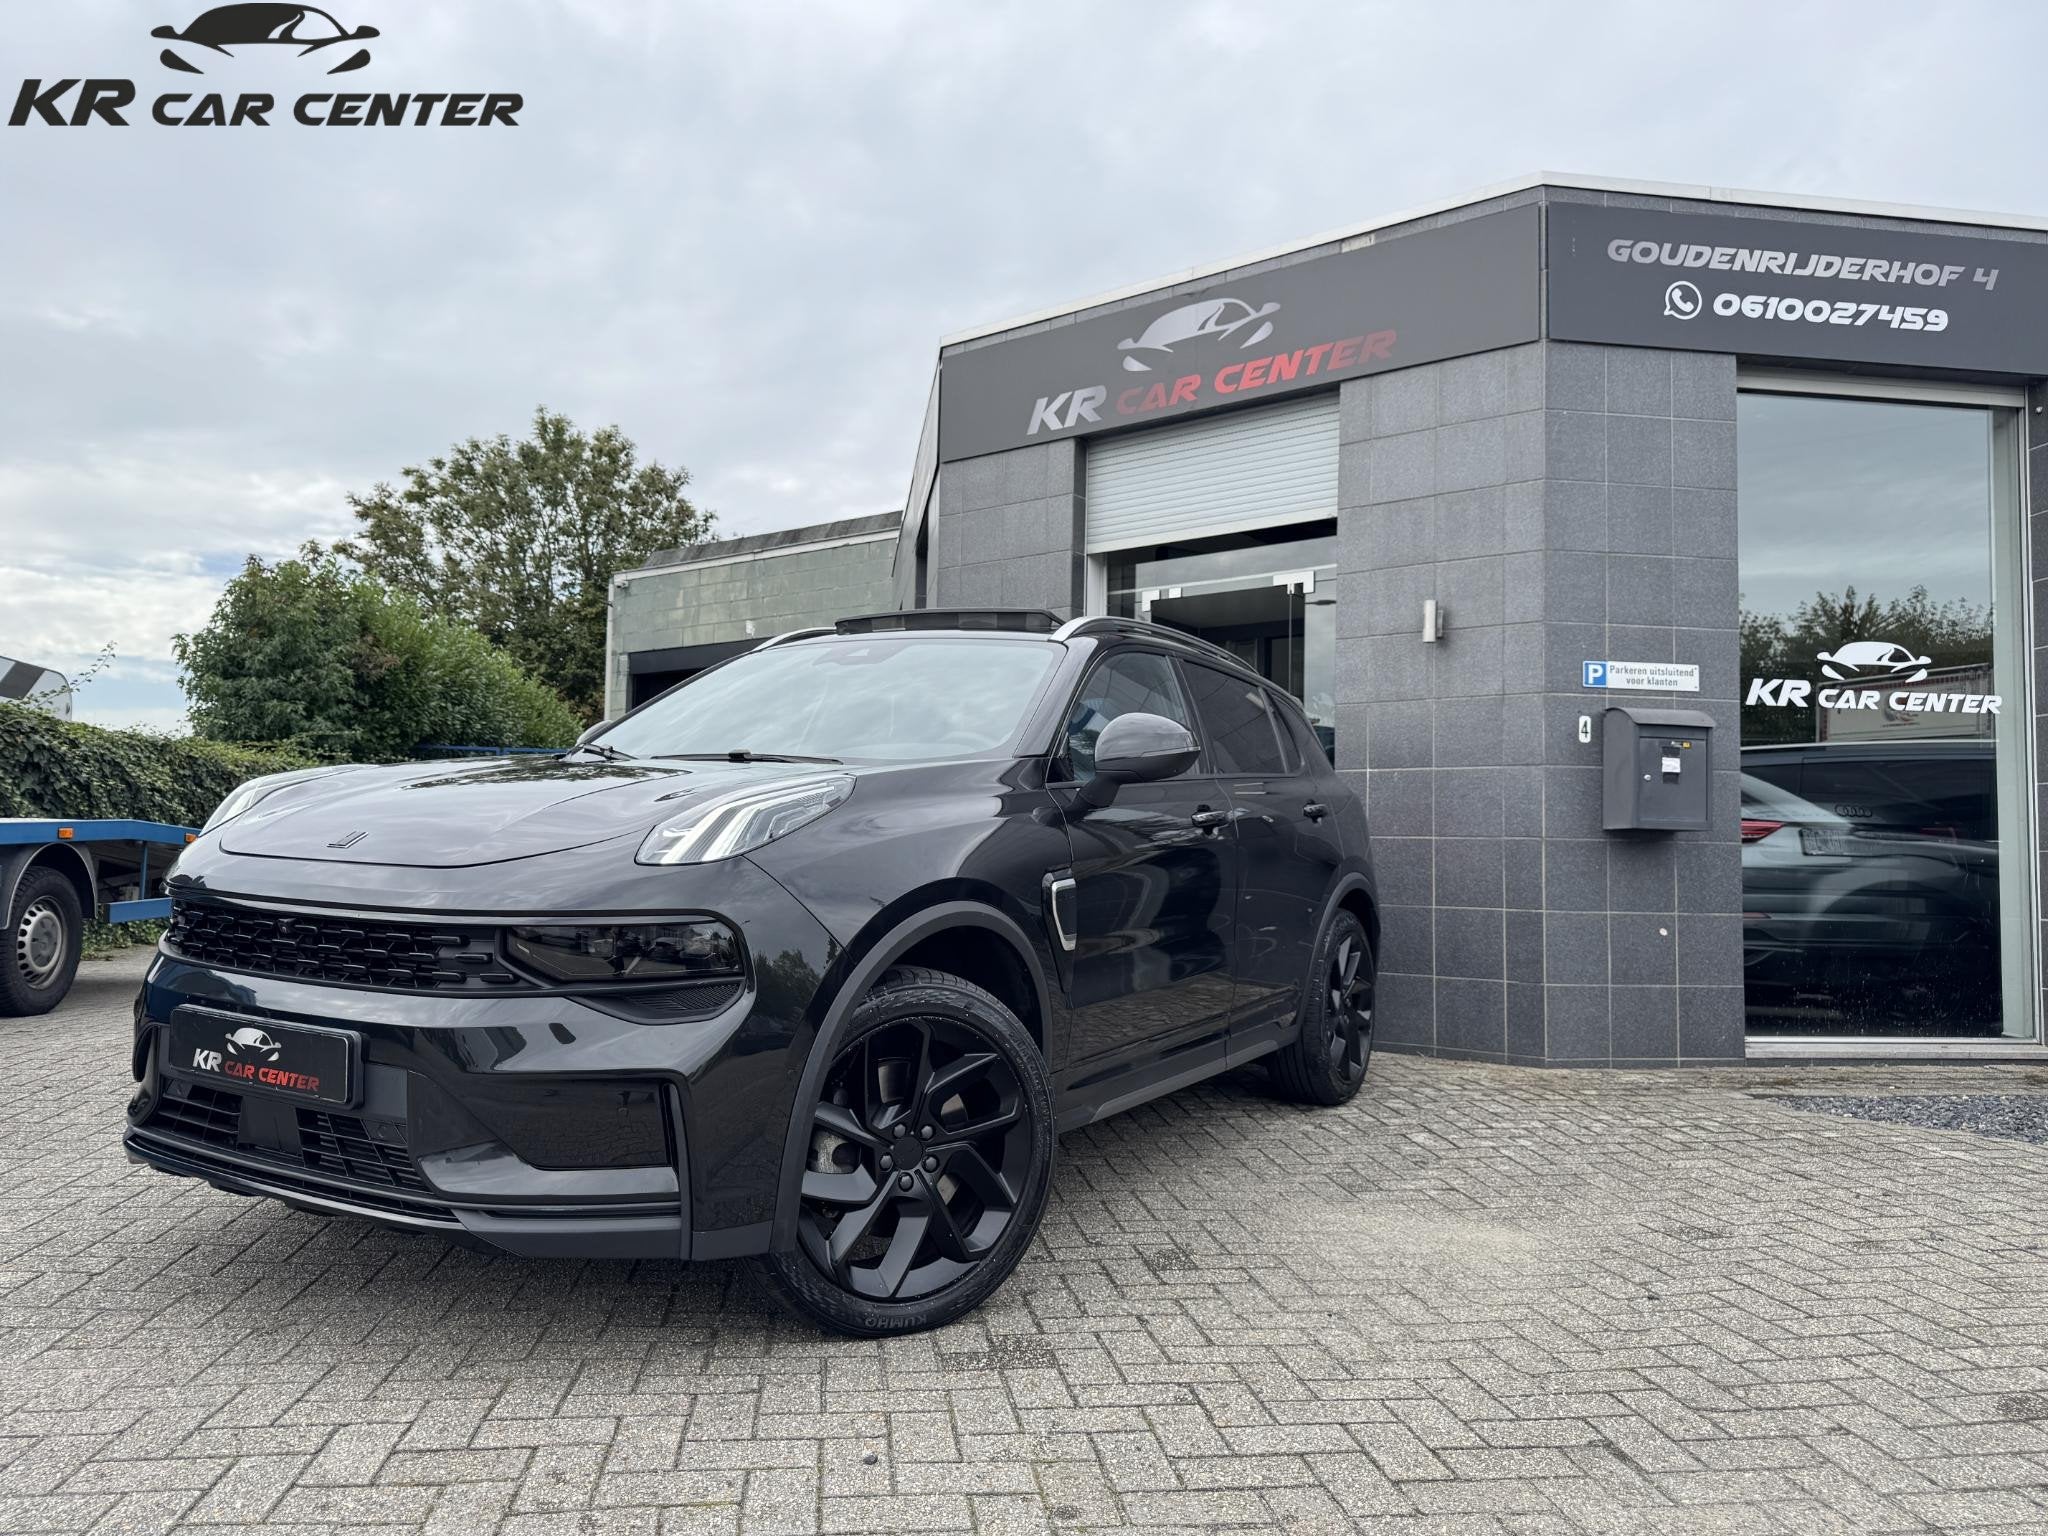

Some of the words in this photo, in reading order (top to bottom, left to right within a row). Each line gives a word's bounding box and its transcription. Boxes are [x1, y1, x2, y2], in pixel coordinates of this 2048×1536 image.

[1607, 238, 1964, 287] GOUDENRIJDERHOF
[1973, 268, 1999, 290] 4
[1713, 293, 1948, 332] 0610027459
[1026, 385, 1107, 435] KR
[1115, 373, 1201, 415] CAR
[1214, 329, 1397, 395] CENTER
[1588, 664, 1603, 684] P
[1609, 665, 1647, 675] Parkeren
[1649, 668, 1694, 677] uitsluitend
[1626, 677, 1645, 685] voor
[1647, 677, 1678, 686] klanten
[1745, 678, 1812, 708] KR
[1818, 689, 1881, 710] CAR
[1888, 692, 2003, 714] CENTER
[1581, 719, 1589, 738] 4
[193, 1048, 222, 1072] KR
[224, 1060, 255, 1079] CAR
[258, 1067, 320, 1092] CENTER
[864, 1312, 928, 1329] KUMHO
